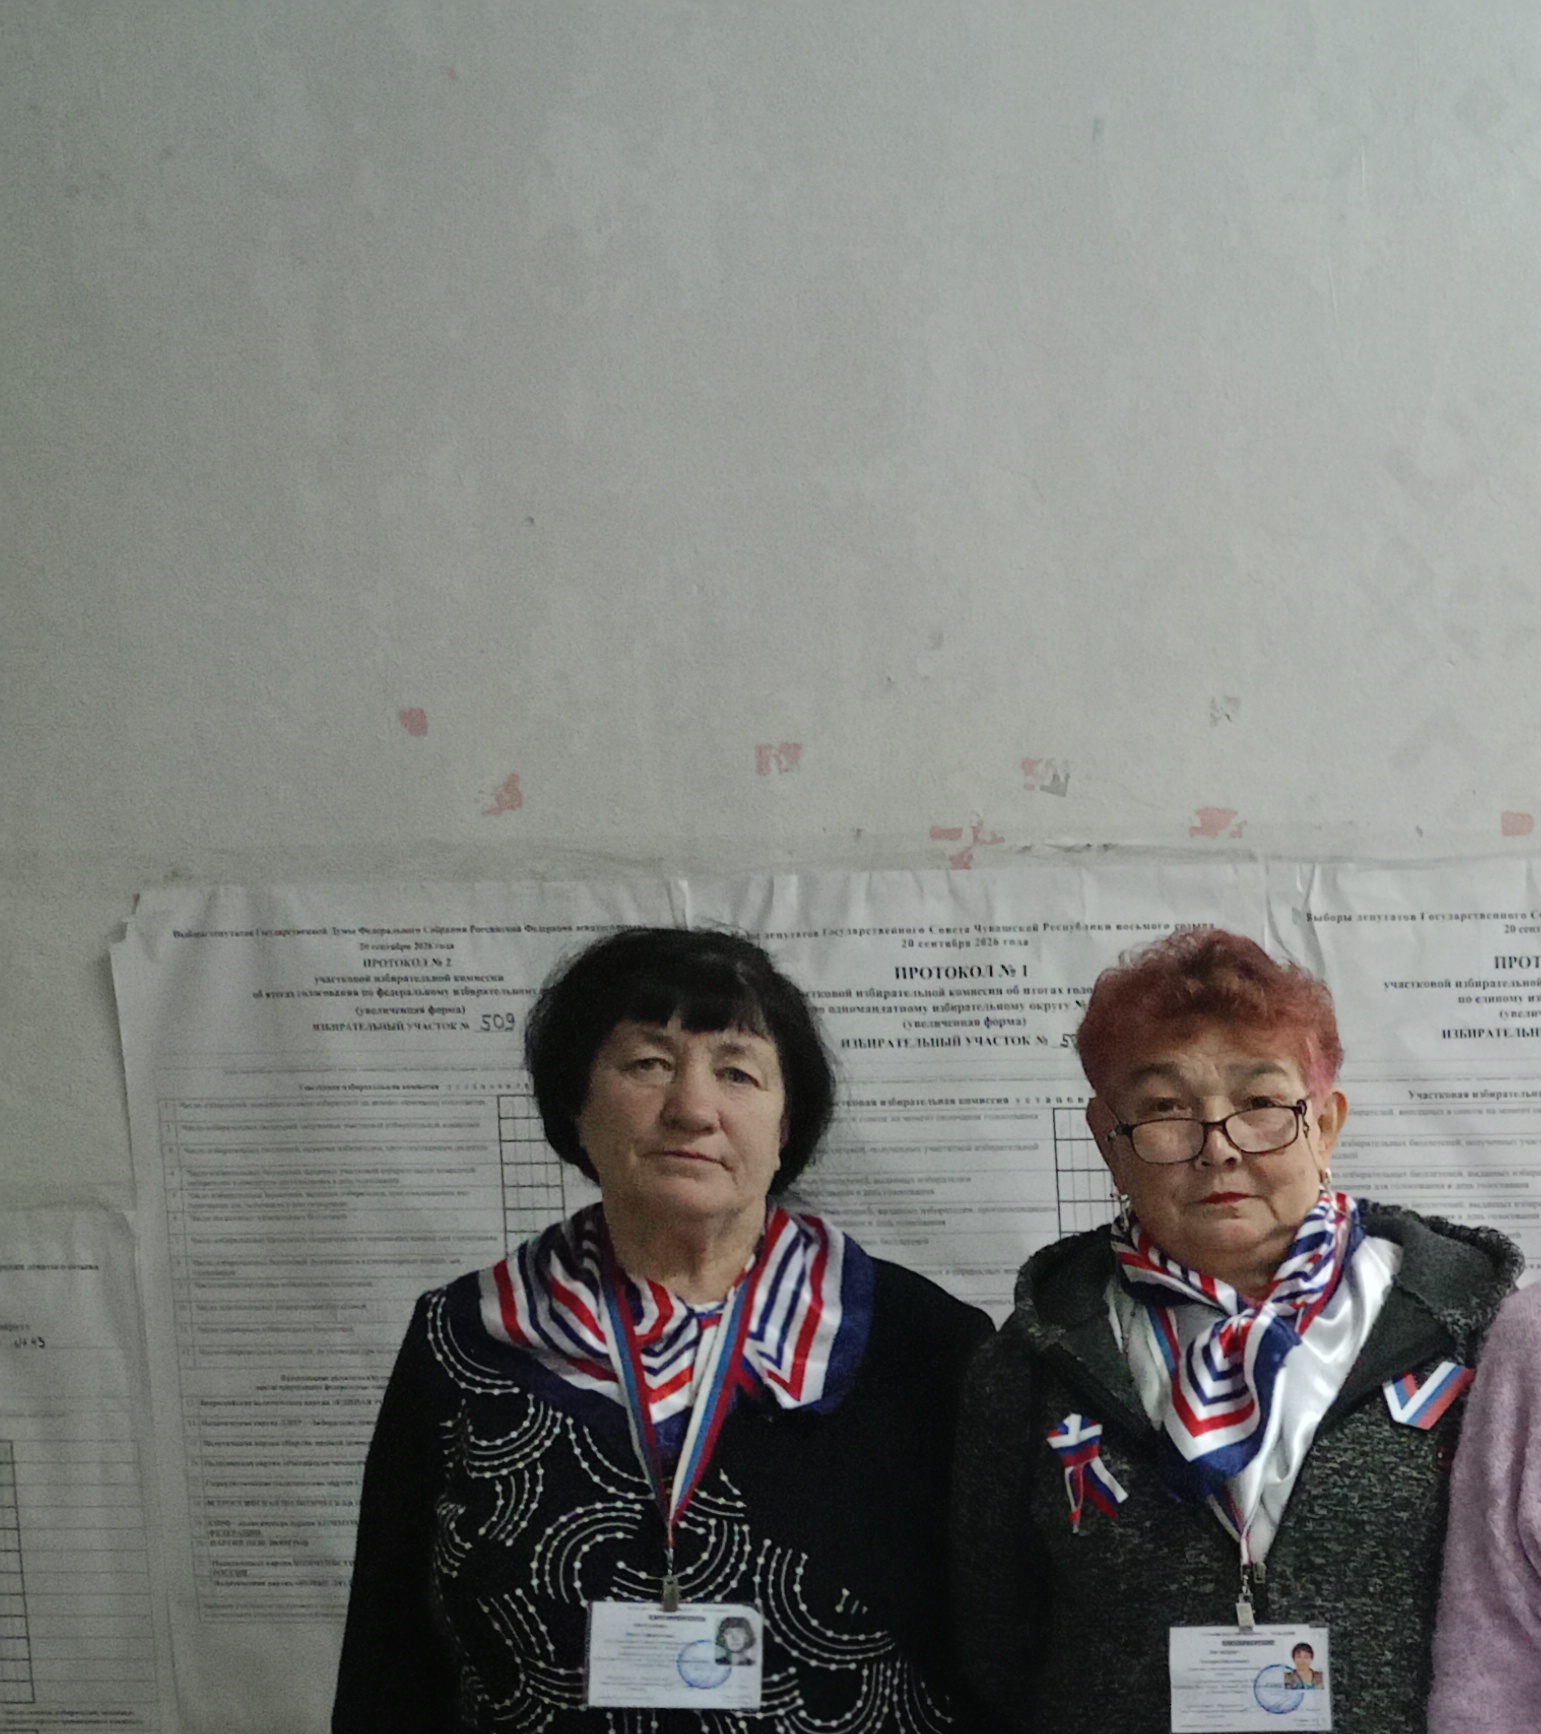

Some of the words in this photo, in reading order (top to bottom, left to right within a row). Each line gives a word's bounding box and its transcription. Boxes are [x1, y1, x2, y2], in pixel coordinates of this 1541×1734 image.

[1357, 912, 1417, 923] депутатов
[974, 923, 1040, 934] Чувашской
[1042, 921, 1112, 933] Республики
[1115, 922, 1171, 932] восьмого
[1504, 923, 1516, 934] 20
[901, 938, 914, 949] 20
[918, 937, 972, 950] сентября
[362, 957, 430, 969] ПРОТОКОЛ
[894, 965, 994, 980] ПРОТОКОЛ
[998, 963, 1017, 979] №
[1021, 964, 1028, 978] 1
[1383, 978, 1452, 991] участковой
[856, 986, 946, 1001] избирательной
[949, 987, 1003, 997] комиссии
[1005, 984, 1020, 996] об
[1023, 986, 1064, 997] итогах
[1457, 994, 1473, 1004] по
[1475, 994, 1523, 1006] единому
[931, 1002, 1025, 1015] избирательному
[480, 1011, 516, 1033] 509
[983, 1015, 1028, 1030] форма)
[840, 1035, 962, 1049] ИЗБИРАТЕЛЬНЫЙ
[965, 1035, 1032, 1048] УЧАСТОК
